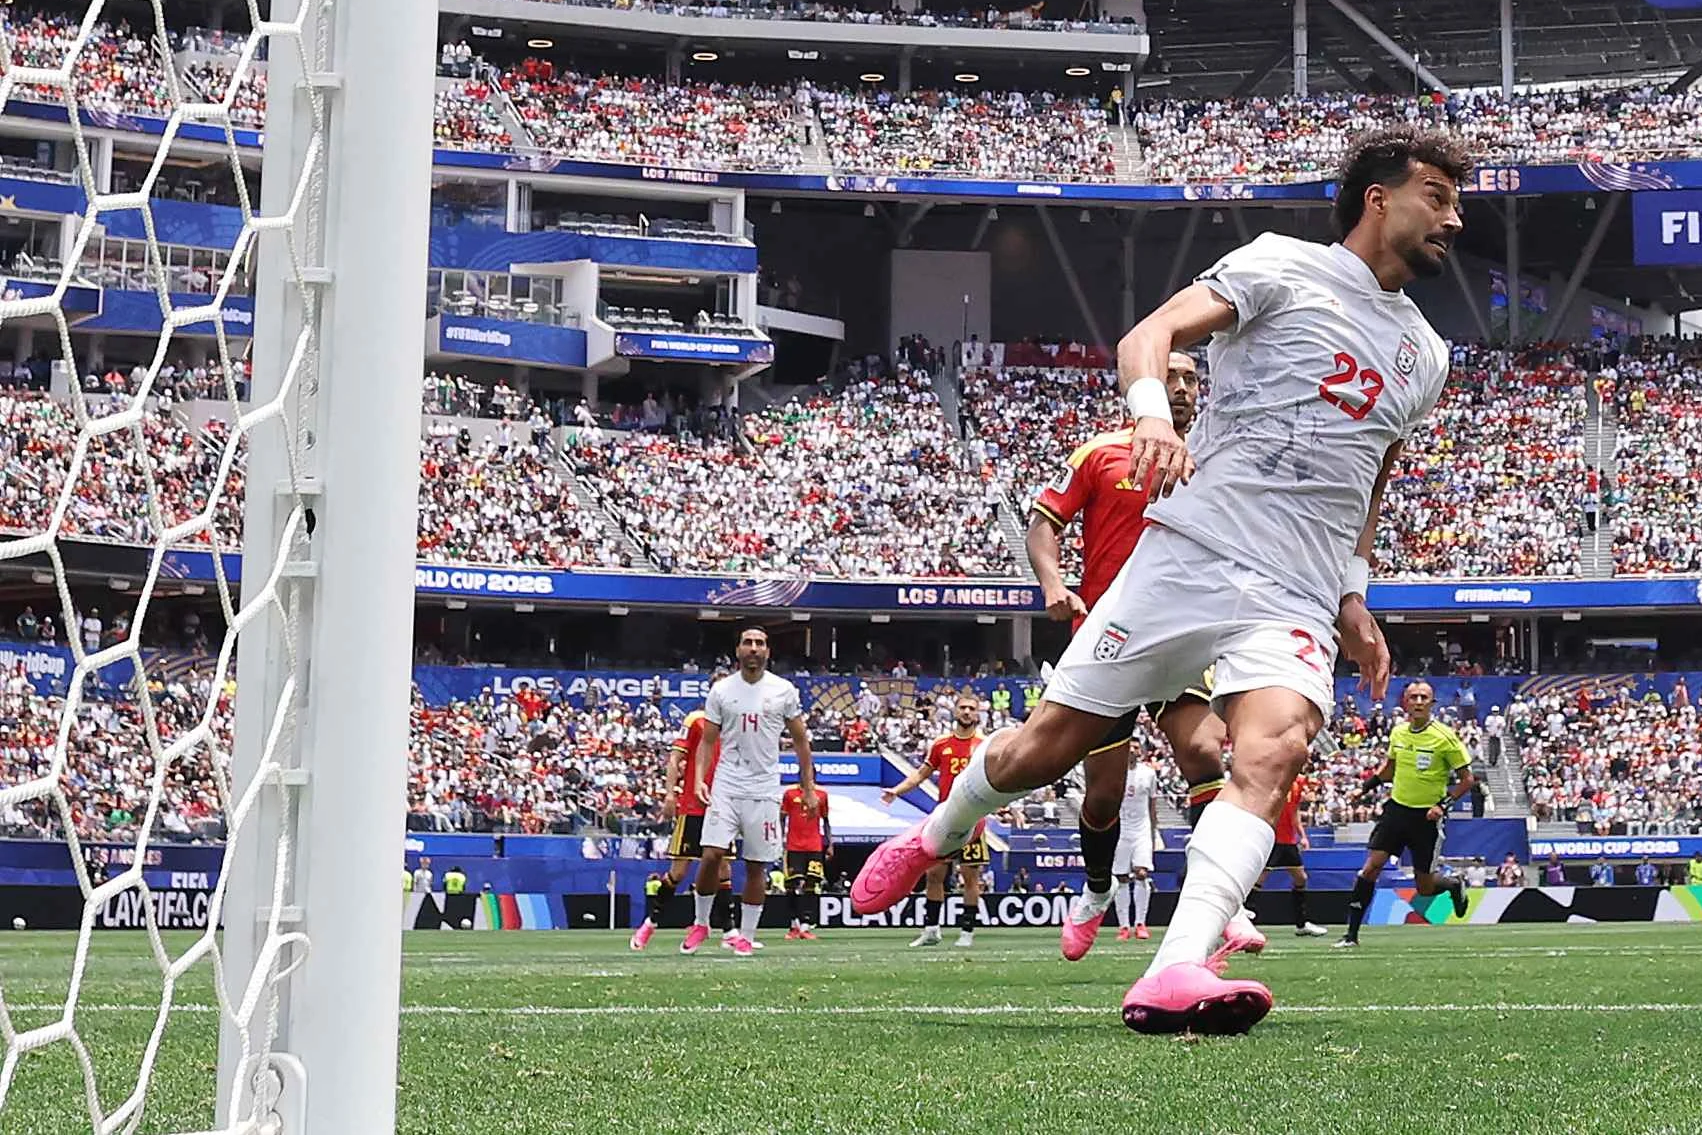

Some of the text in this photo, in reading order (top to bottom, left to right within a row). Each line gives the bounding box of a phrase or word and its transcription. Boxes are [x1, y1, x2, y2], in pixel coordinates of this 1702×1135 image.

[1318, 352, 1385, 420] 23
[416, 570, 554, 594] RLD CUP 2026
[898, 588, 1033, 606] LOS ANGELES
[494, 677, 555, 695] LOS
[742, 713, 758, 733] 14
[963, 843, 981, 860] 23
[1531, 842, 1552, 855] IFA
[1552, 842, 1603, 855] WORLD
[1603, 841, 1631, 854] CUP
[1036, 855, 1065, 867] LOS
